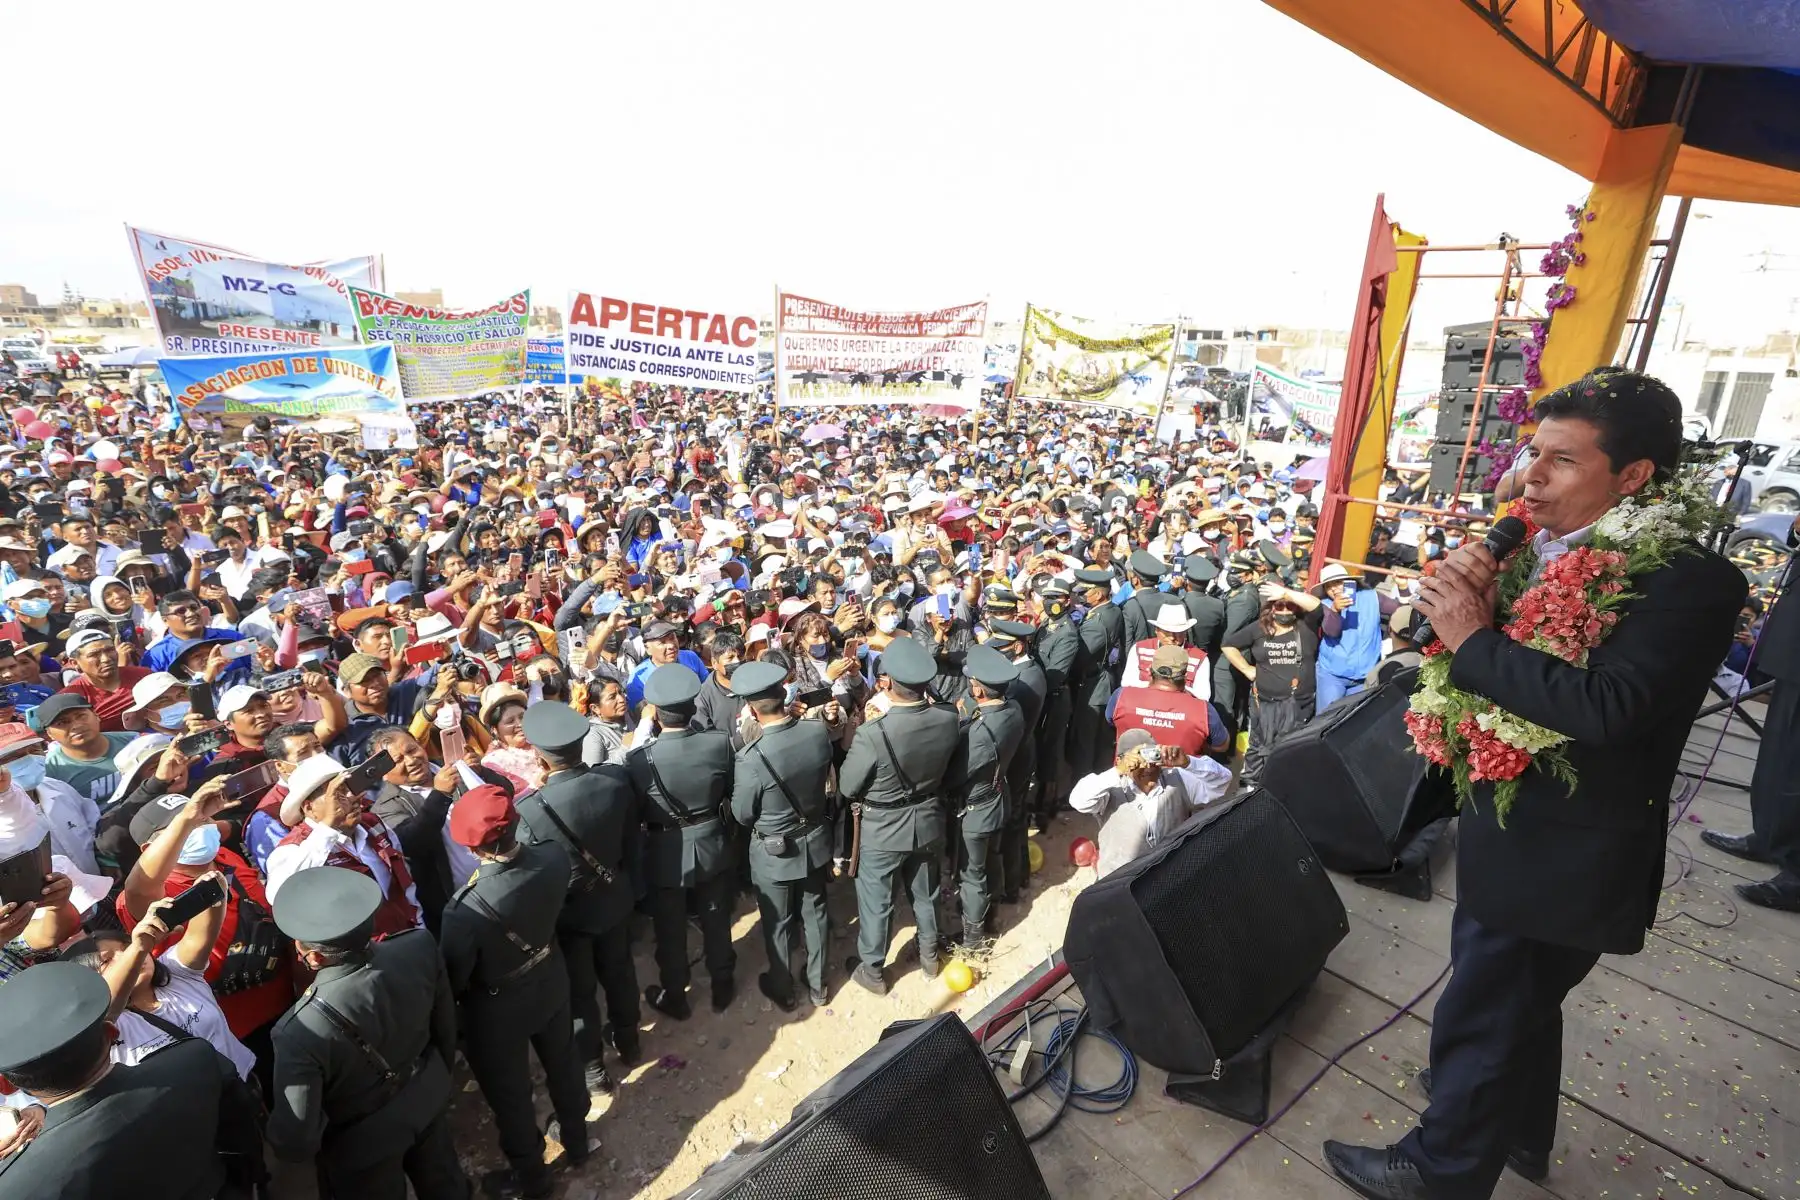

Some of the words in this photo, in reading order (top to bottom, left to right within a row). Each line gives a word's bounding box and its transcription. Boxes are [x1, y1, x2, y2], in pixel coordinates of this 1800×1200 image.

[222, 275, 297, 296] MZ-G
[570, 292, 758, 348] APERTAC
[167, 337, 187, 351] SR.
[218, 324, 321, 346] PRESENTE
[368, 330, 411, 344] SECOR
[467, 330, 481, 341] TE
[570, 332, 606, 349] PIDE
[610, 338, 682, 359] JUSTICIA
[686, 348, 724, 363] ANTE
[728, 353, 755, 367] LAS
[784, 337, 839, 352] QUEREMOS
[842, 339, 887, 354] URGENTE
[905, 339, 980, 355] FORALIZACIO
[291, 357, 318, 375] DE
[570, 353, 636, 372] INSTANCIAS
[639, 361, 755, 385] CORRESPONDIENTES
